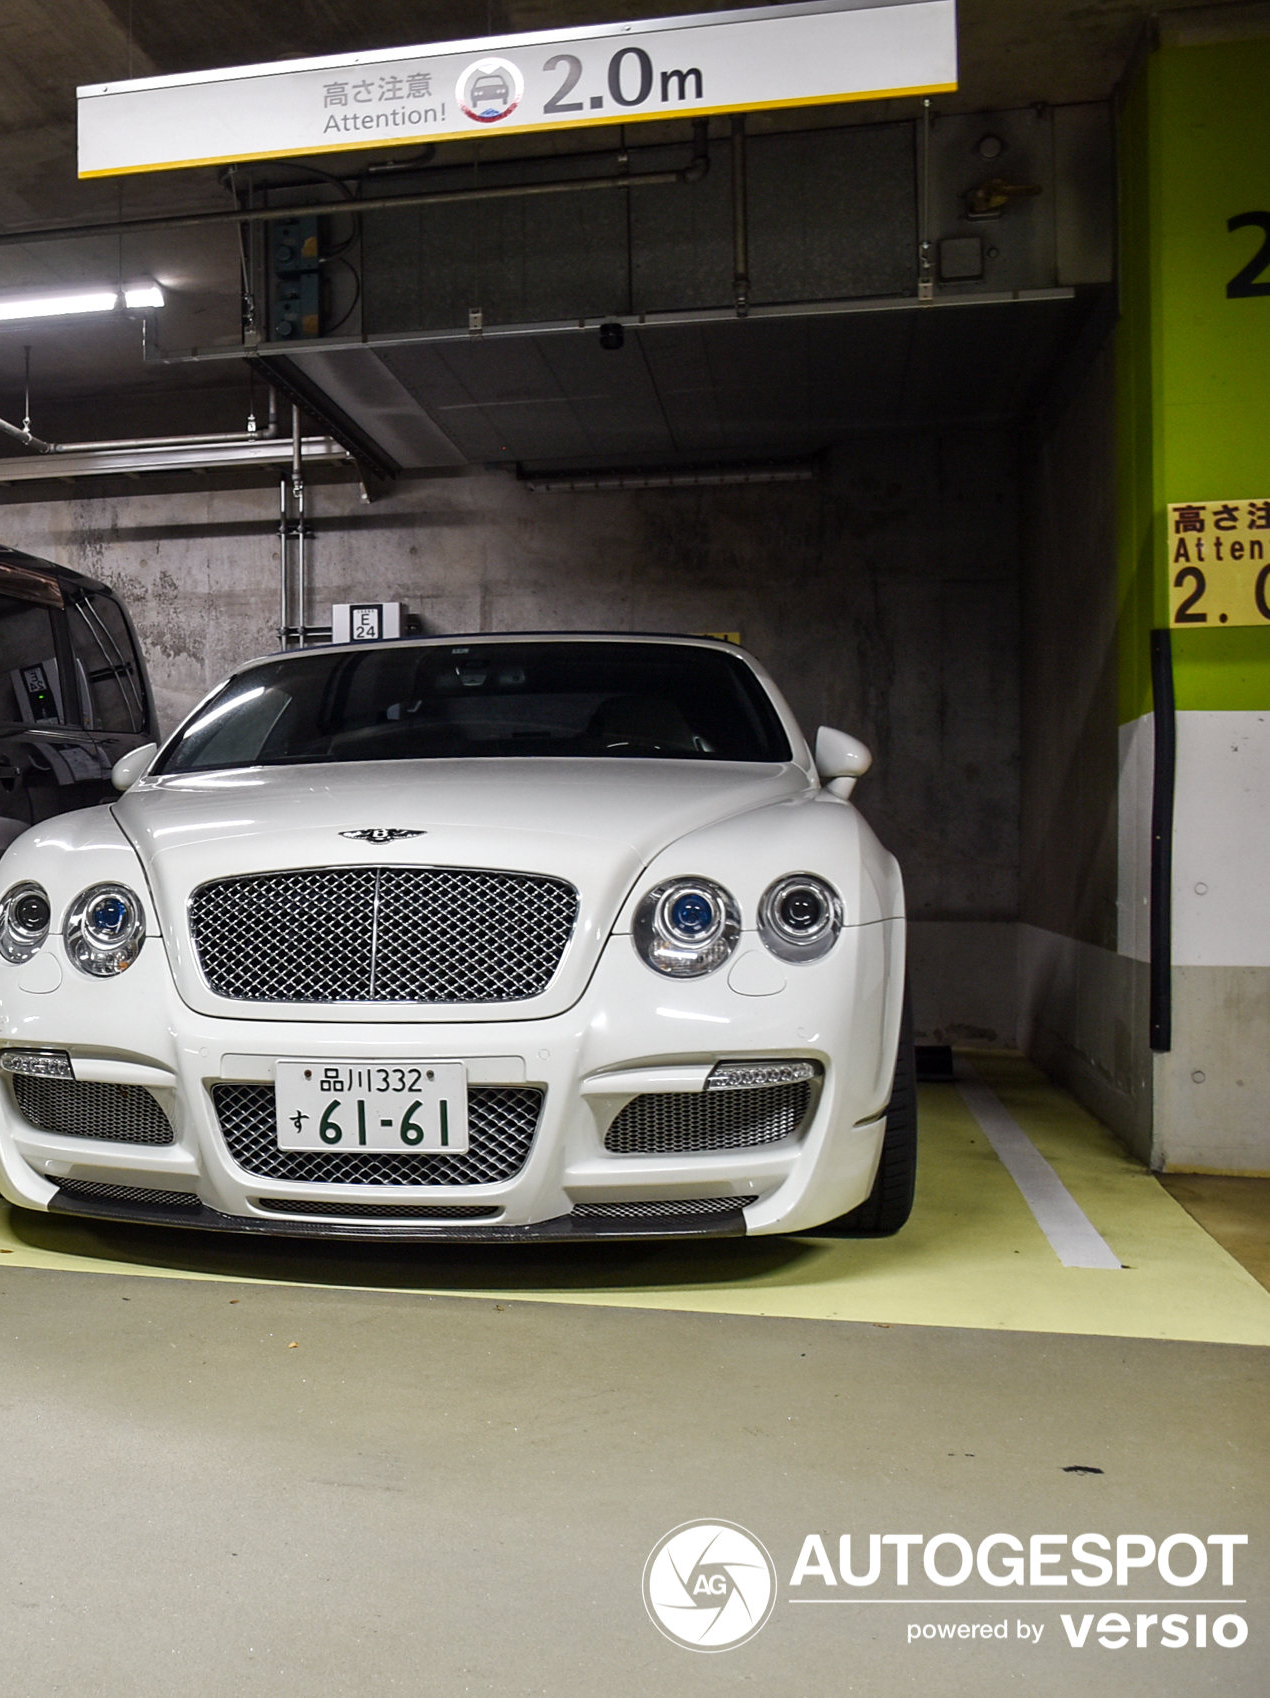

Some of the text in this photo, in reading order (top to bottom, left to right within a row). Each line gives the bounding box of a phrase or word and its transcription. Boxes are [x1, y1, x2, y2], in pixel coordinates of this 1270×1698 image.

[323, 72, 432, 109] 高さ注意
[542, 46, 704, 115] 2.0m
[323, 102, 446, 134] Attention!
[356, 626, 376, 638] 24
[361, 613, 370, 626] E
[289, 1099, 449, 1146] す 61-61
